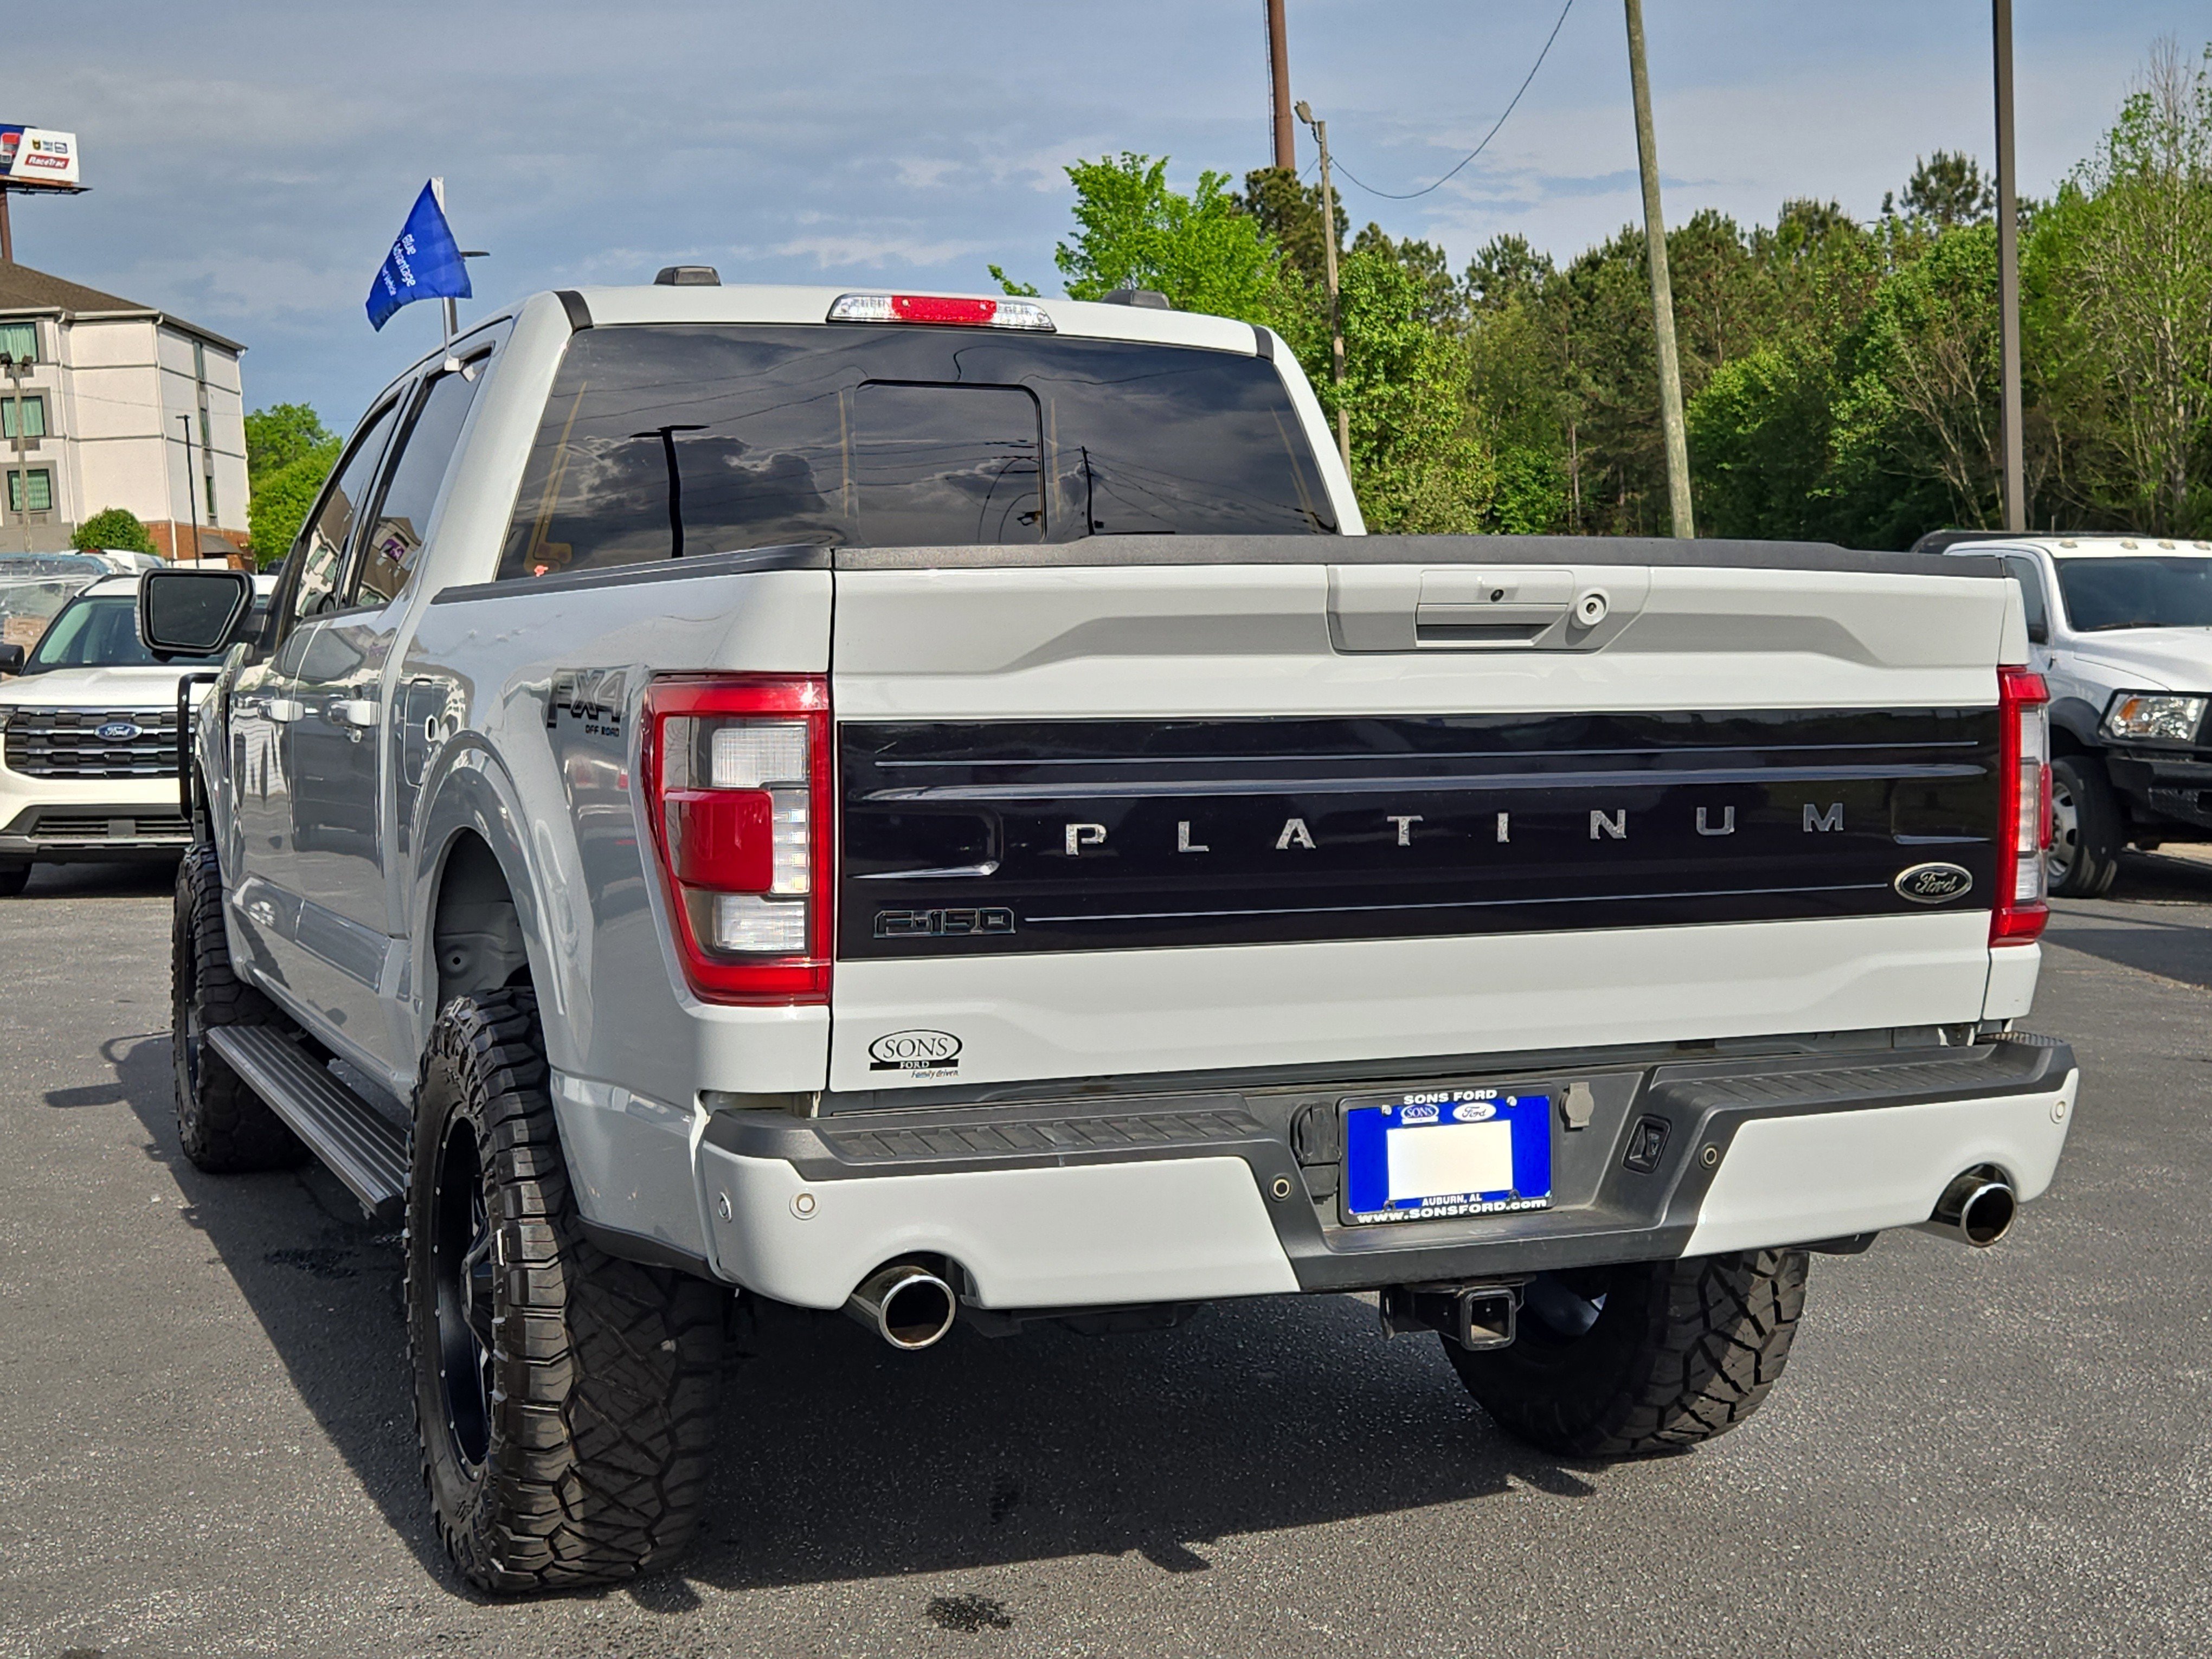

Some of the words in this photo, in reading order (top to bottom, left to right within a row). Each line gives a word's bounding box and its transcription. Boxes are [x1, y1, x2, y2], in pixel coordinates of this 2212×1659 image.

[547, 668, 626, 728] FX4
[105, 726, 131, 736] Ford
[586, 724, 599, 735] OFF
[601, 725, 620, 738] ROAD
[1066, 802, 1844, 856] PLATINUM
[1914, 871, 1958, 893] Ford
[883, 1037, 948, 1059] SONS
[899, 1060, 930, 1069] FORD
[911, 1070, 936, 1079] Family
[1404, 1091, 1449, 1105] SONS
[1454, 1090, 1497, 1102] FORD
[1406, 1105, 1433, 1118] SONS
[1462, 1105, 1487, 1118] Ford
[1422, 1194, 1467, 1207] AUBURN,
[1469, 1193, 1482, 1203] AL
[1358, 1199, 1547, 1224] www.SONSFORD.com
